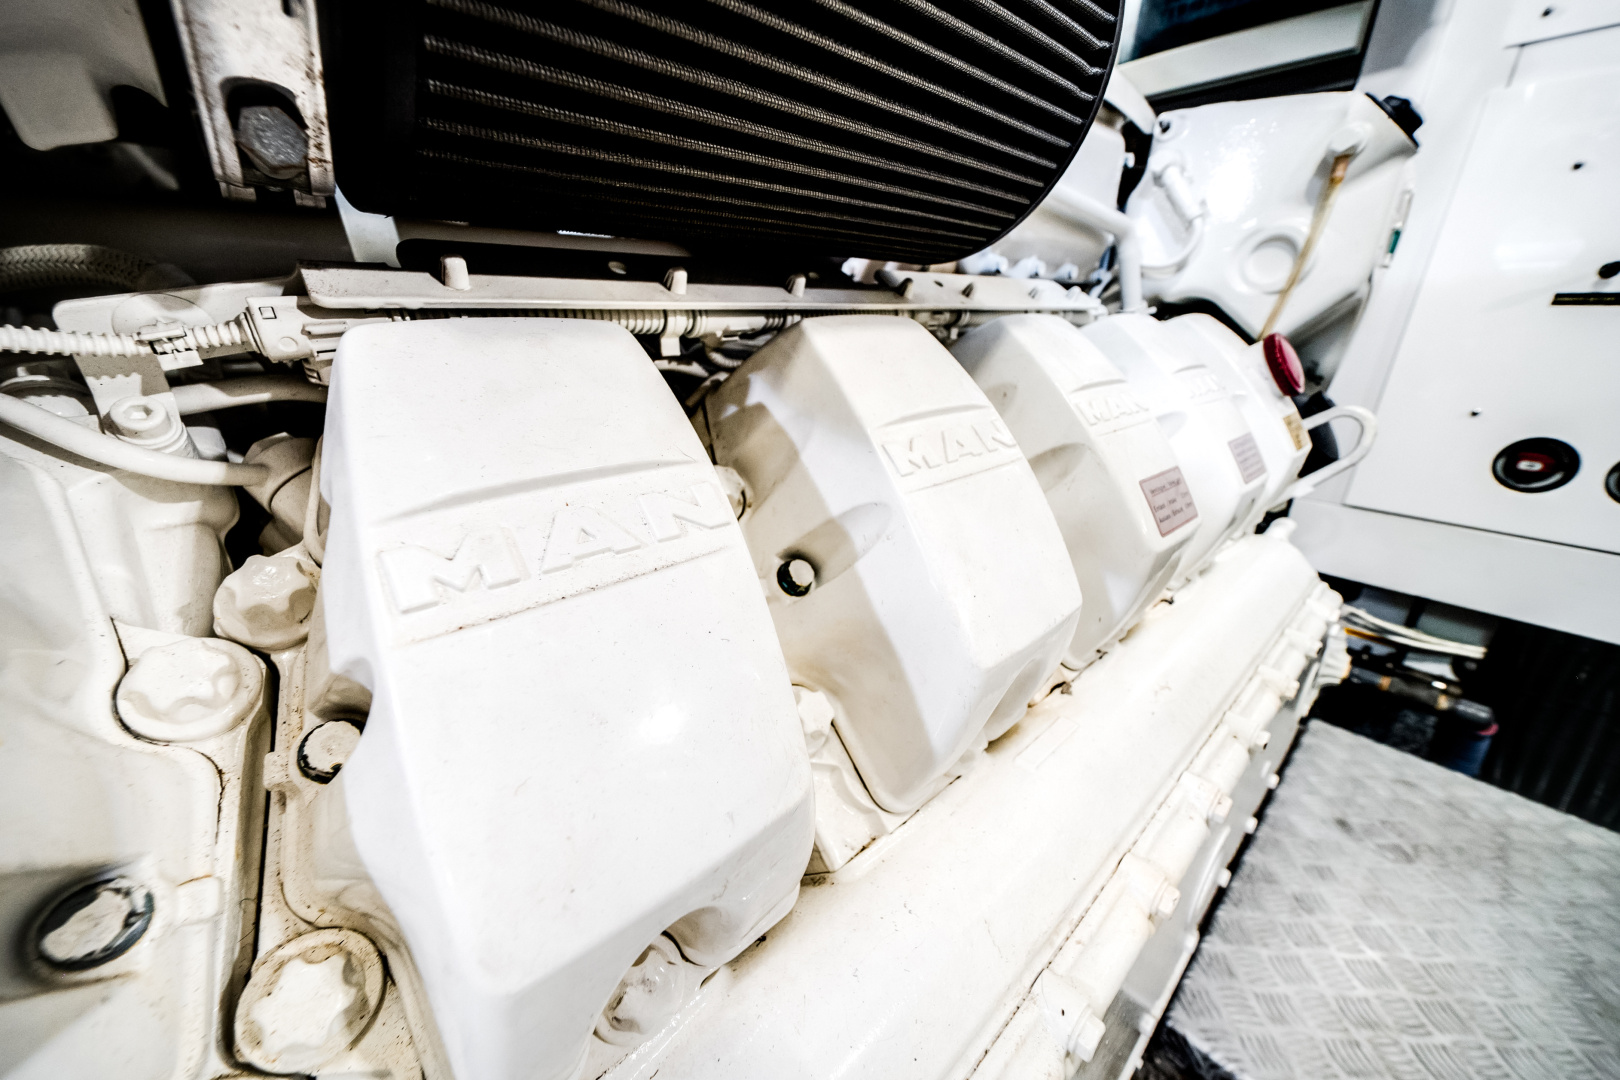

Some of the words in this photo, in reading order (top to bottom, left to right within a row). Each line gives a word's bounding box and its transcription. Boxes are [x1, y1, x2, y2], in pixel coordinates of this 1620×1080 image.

[1075, 391, 1149, 426] MAN
[882, 419, 1017, 477] MAN
[379, 481, 732, 614] MAN
